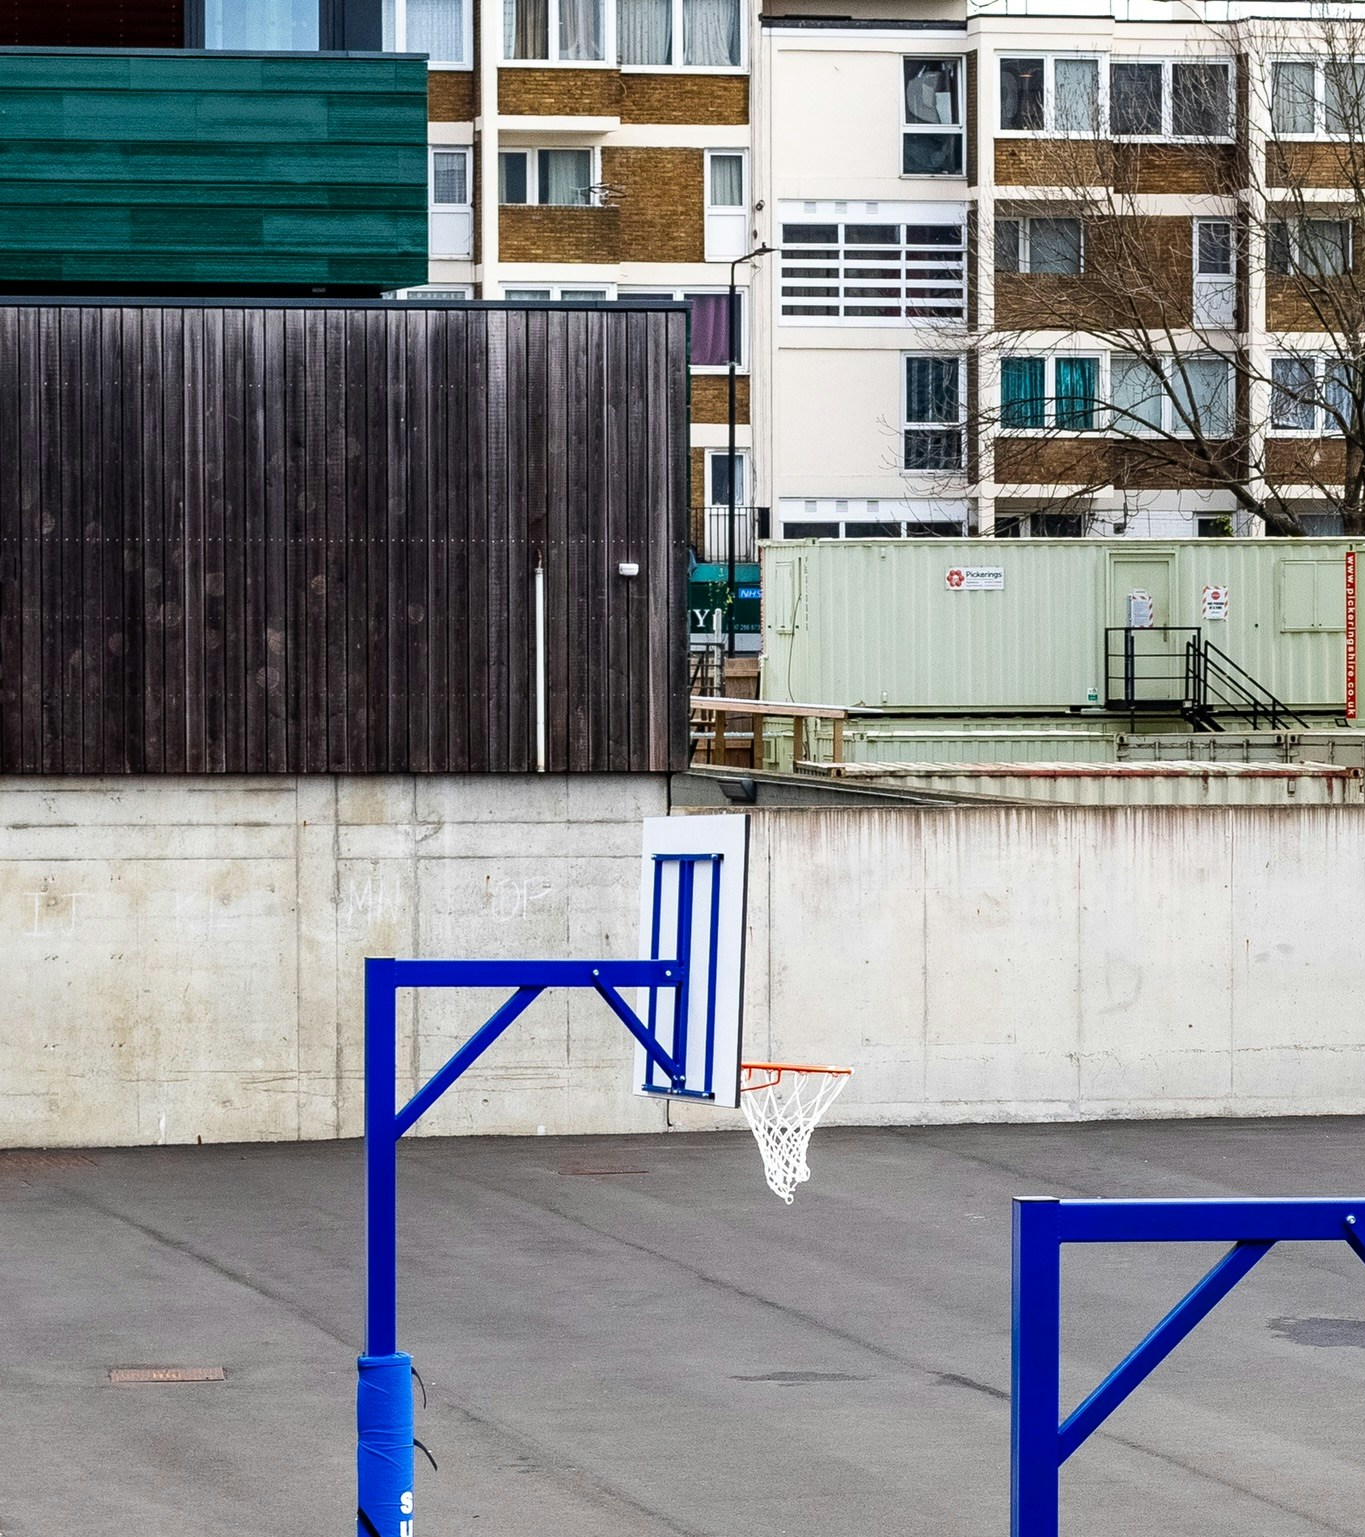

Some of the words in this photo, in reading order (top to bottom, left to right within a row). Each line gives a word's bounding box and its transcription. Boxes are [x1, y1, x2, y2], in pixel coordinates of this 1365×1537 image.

[966, 571, 1002, 579] Pickerings
[740, 588, 762, 598] NHS
[1346, 555, 1356, 715] www.pickeringshire.co.uk
